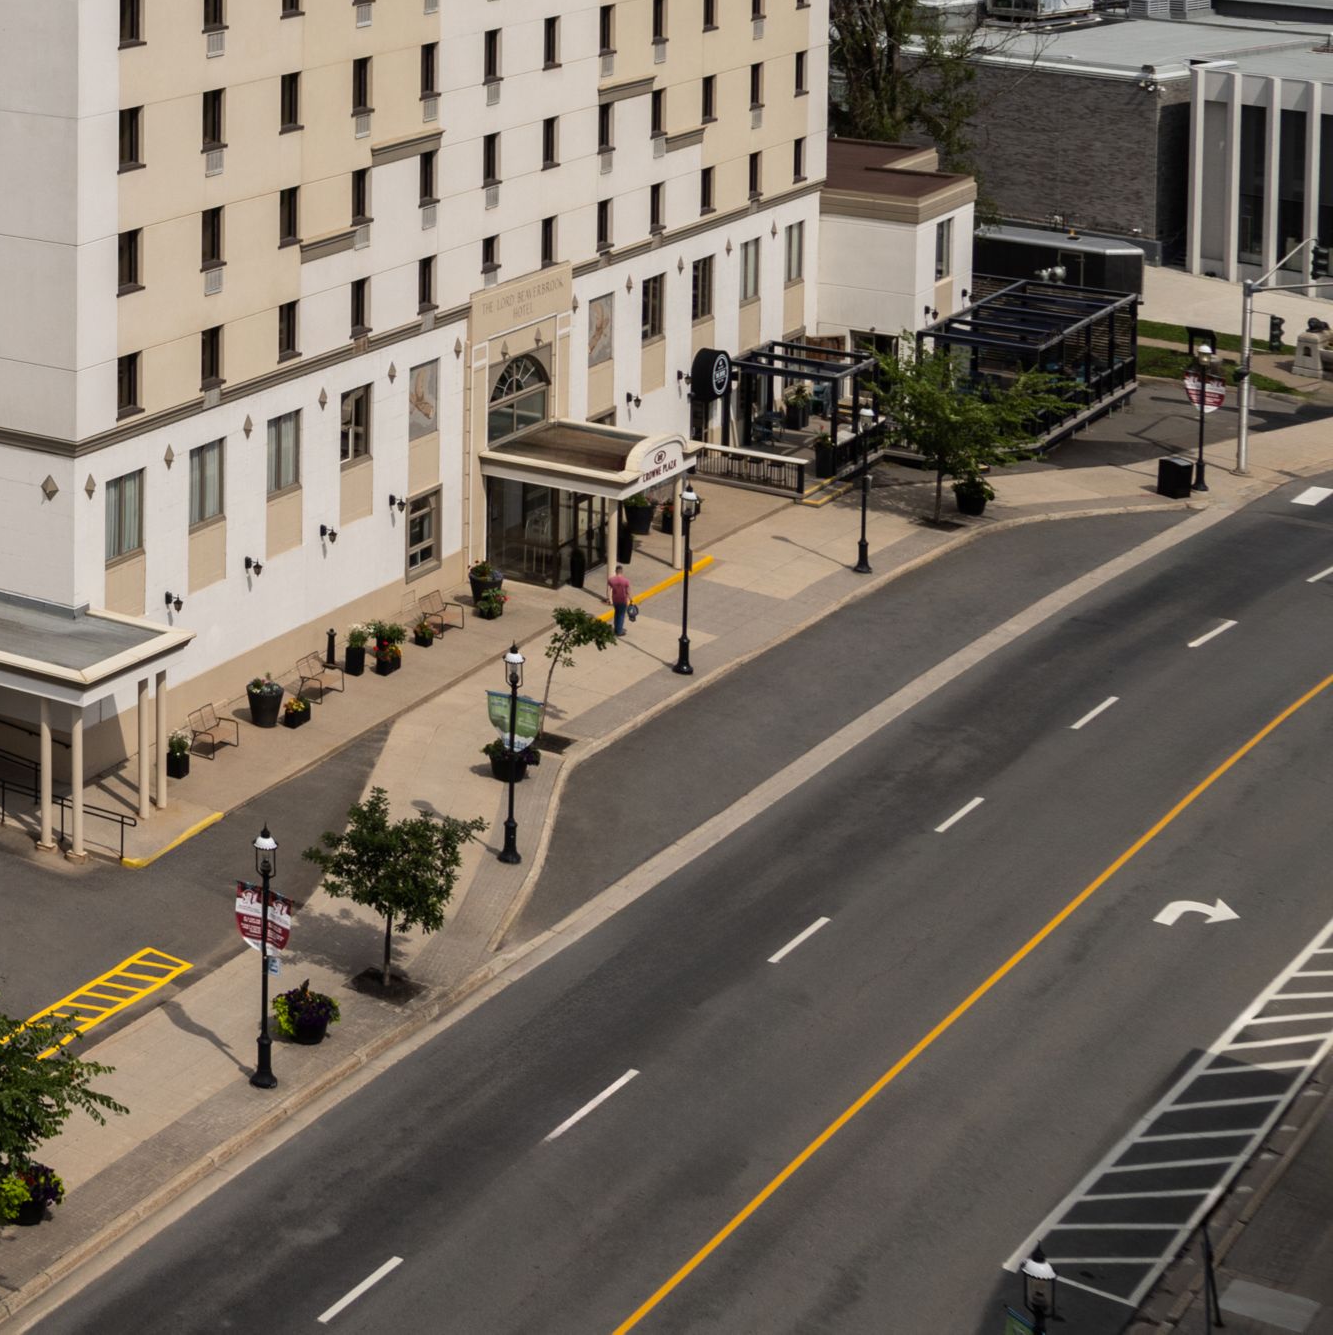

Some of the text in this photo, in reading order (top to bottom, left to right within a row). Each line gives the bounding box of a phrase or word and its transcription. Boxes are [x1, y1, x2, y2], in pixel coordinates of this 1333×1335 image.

[481, 277, 565, 315] THE LORD BEAVERBROOK
[512, 302, 534, 318] HOTEL
[642, 459, 677, 483] CROWNE PLAZA
